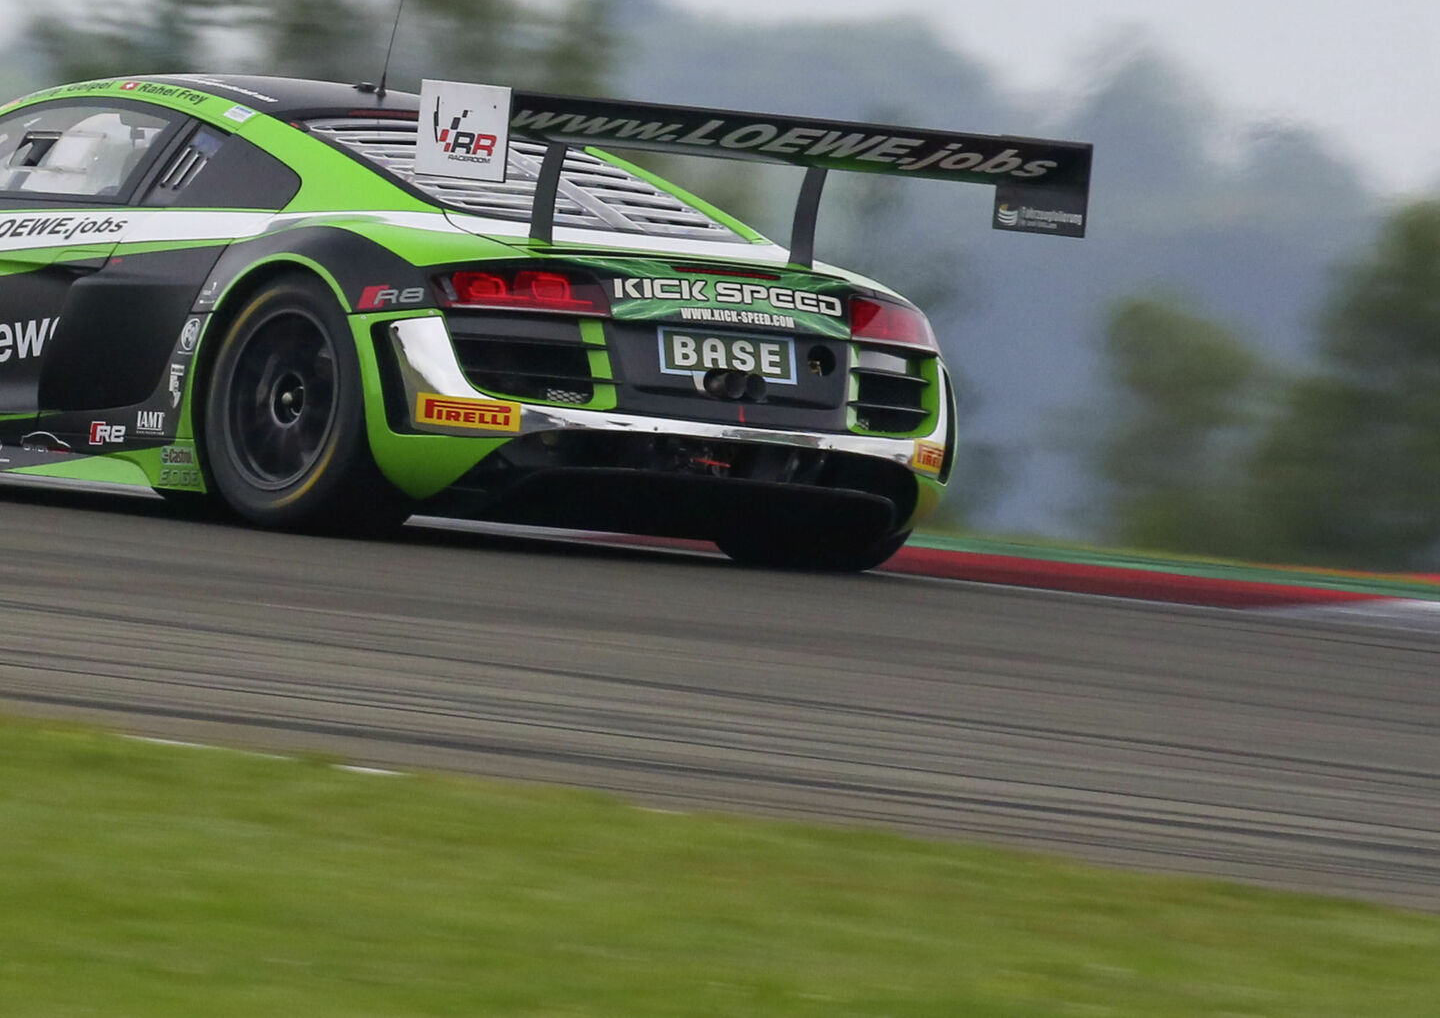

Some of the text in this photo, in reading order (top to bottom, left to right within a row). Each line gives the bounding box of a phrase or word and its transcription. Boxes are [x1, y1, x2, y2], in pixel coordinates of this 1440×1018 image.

[138, 83, 179, 97] Rahel
[177, 90, 208, 105] Frey
[511, 109, 1058, 177] www.LOEWE.jobs
[366, 287, 424, 307] R8
[613, 278, 842, 317] KICK SPEED
[680, 308, 795, 329] WWW.KICK-SPEED.COM
[672, 335, 782, 375] BASE
[425, 399, 512, 426] PIRELLI
